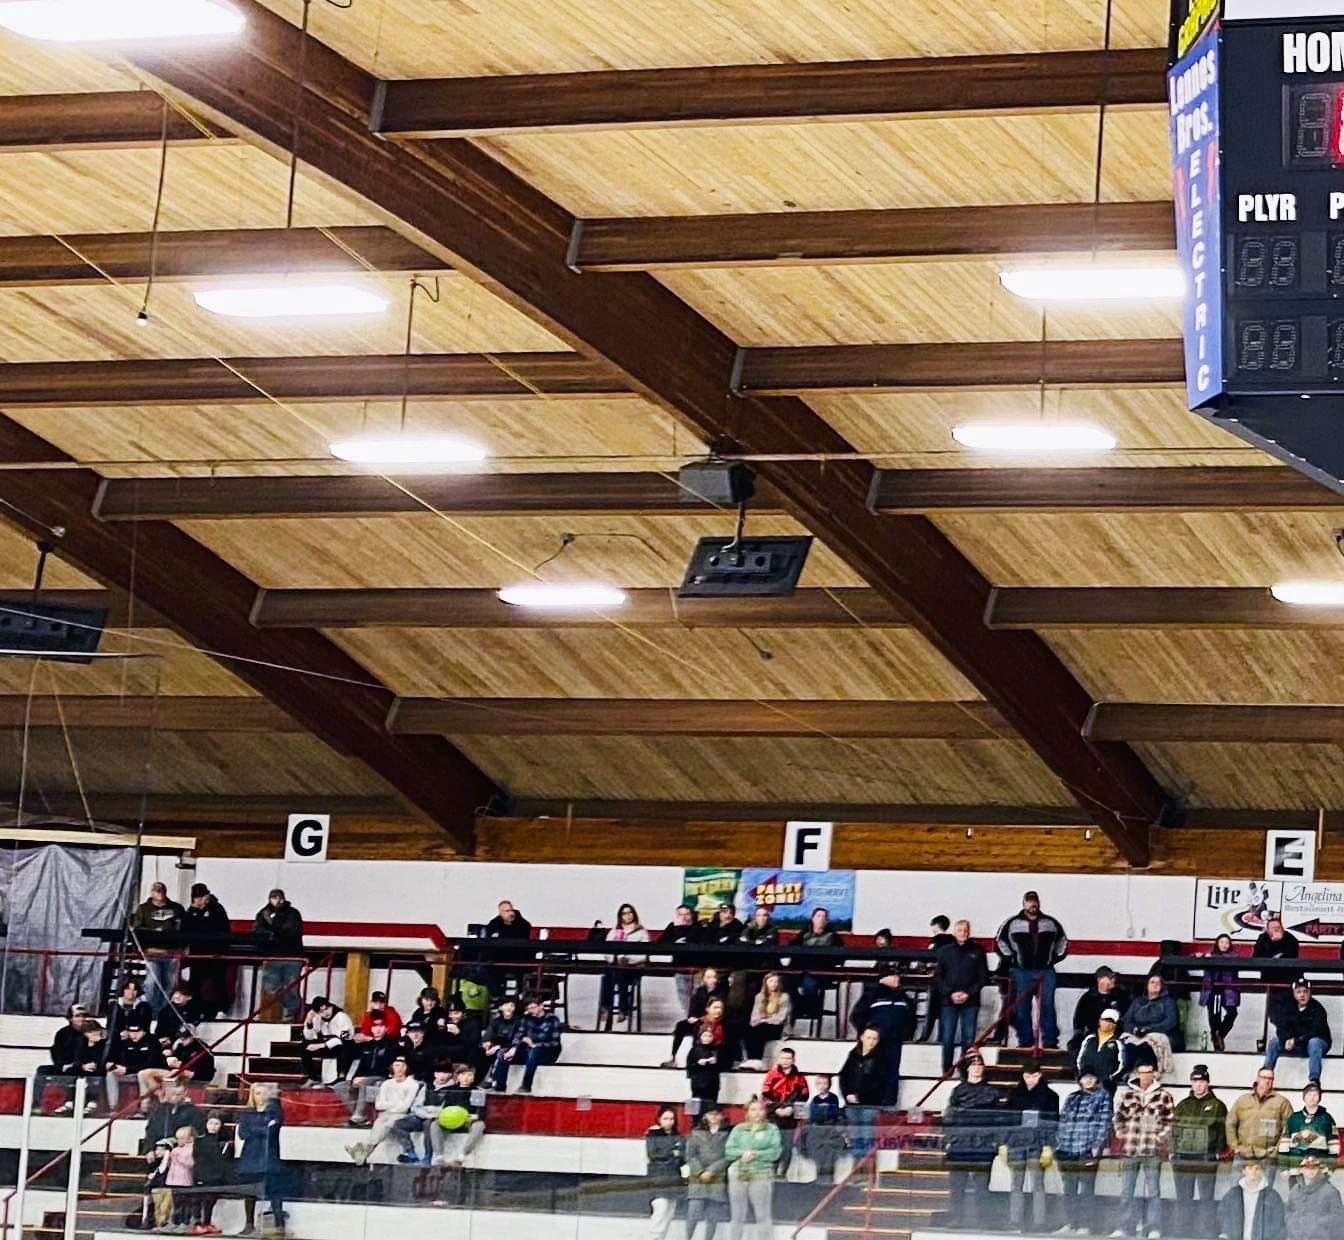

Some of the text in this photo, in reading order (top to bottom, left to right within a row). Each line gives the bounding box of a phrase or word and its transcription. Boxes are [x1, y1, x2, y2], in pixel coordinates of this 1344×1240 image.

[1238, 193, 1297, 222] PLYR
[1189, 149, 1209, 392] ELECTRIC
[292, 819, 324, 858] G
[795, 828, 821, 865] F
[1273, 837, 1305, 876] E
[1207, 885, 1241, 910] Lite
